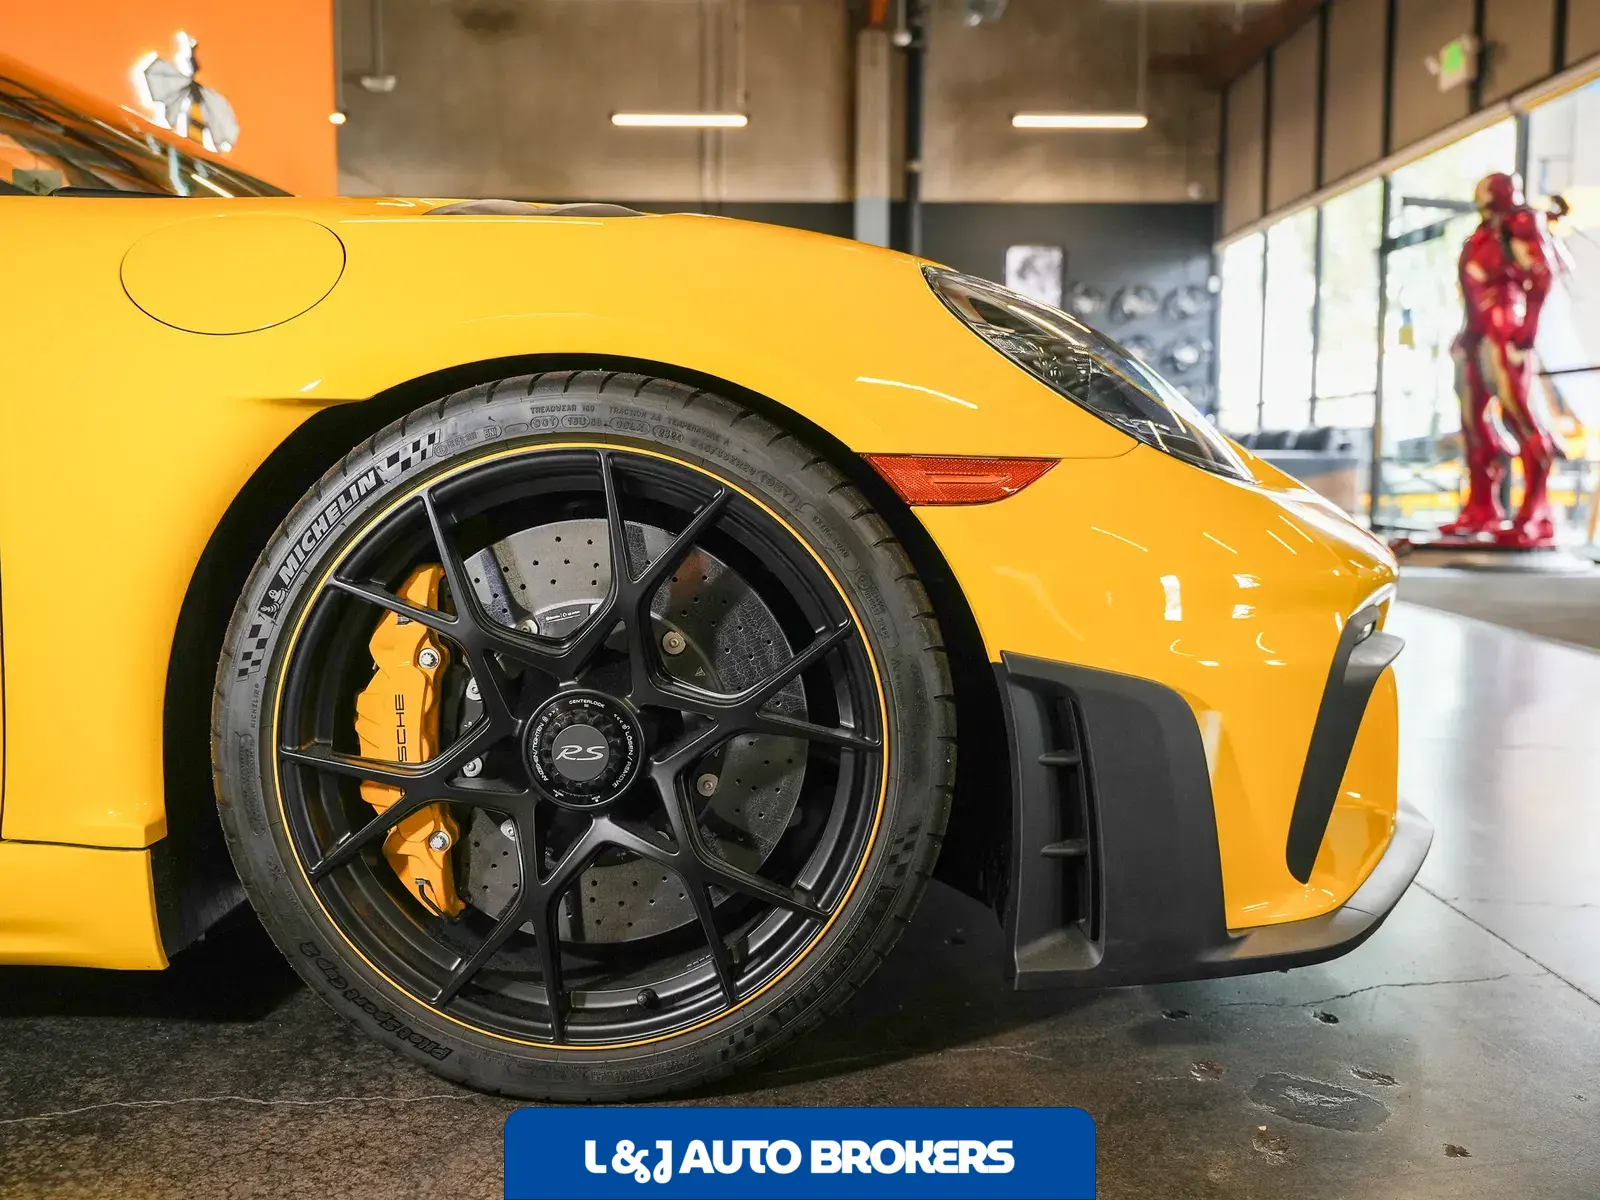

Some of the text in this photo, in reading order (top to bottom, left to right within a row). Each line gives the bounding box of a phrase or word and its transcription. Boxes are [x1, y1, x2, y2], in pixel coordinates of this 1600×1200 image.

[530, 404, 576, 414] TREADWEAR
[608, 406, 647, 418] TRACTION
[278, 469, 380, 586] MICHELIN
[568, 699, 605, 709] CENTERLOCK
[395, 694, 407, 762] SCHE
[556, 745, 606, 761] RS
[299, 942, 319, 957] 2
[316, 957, 349, 990] Cup
[344, 988, 398, 1032] Sport
[396, 1028, 453, 1060] Pilot
